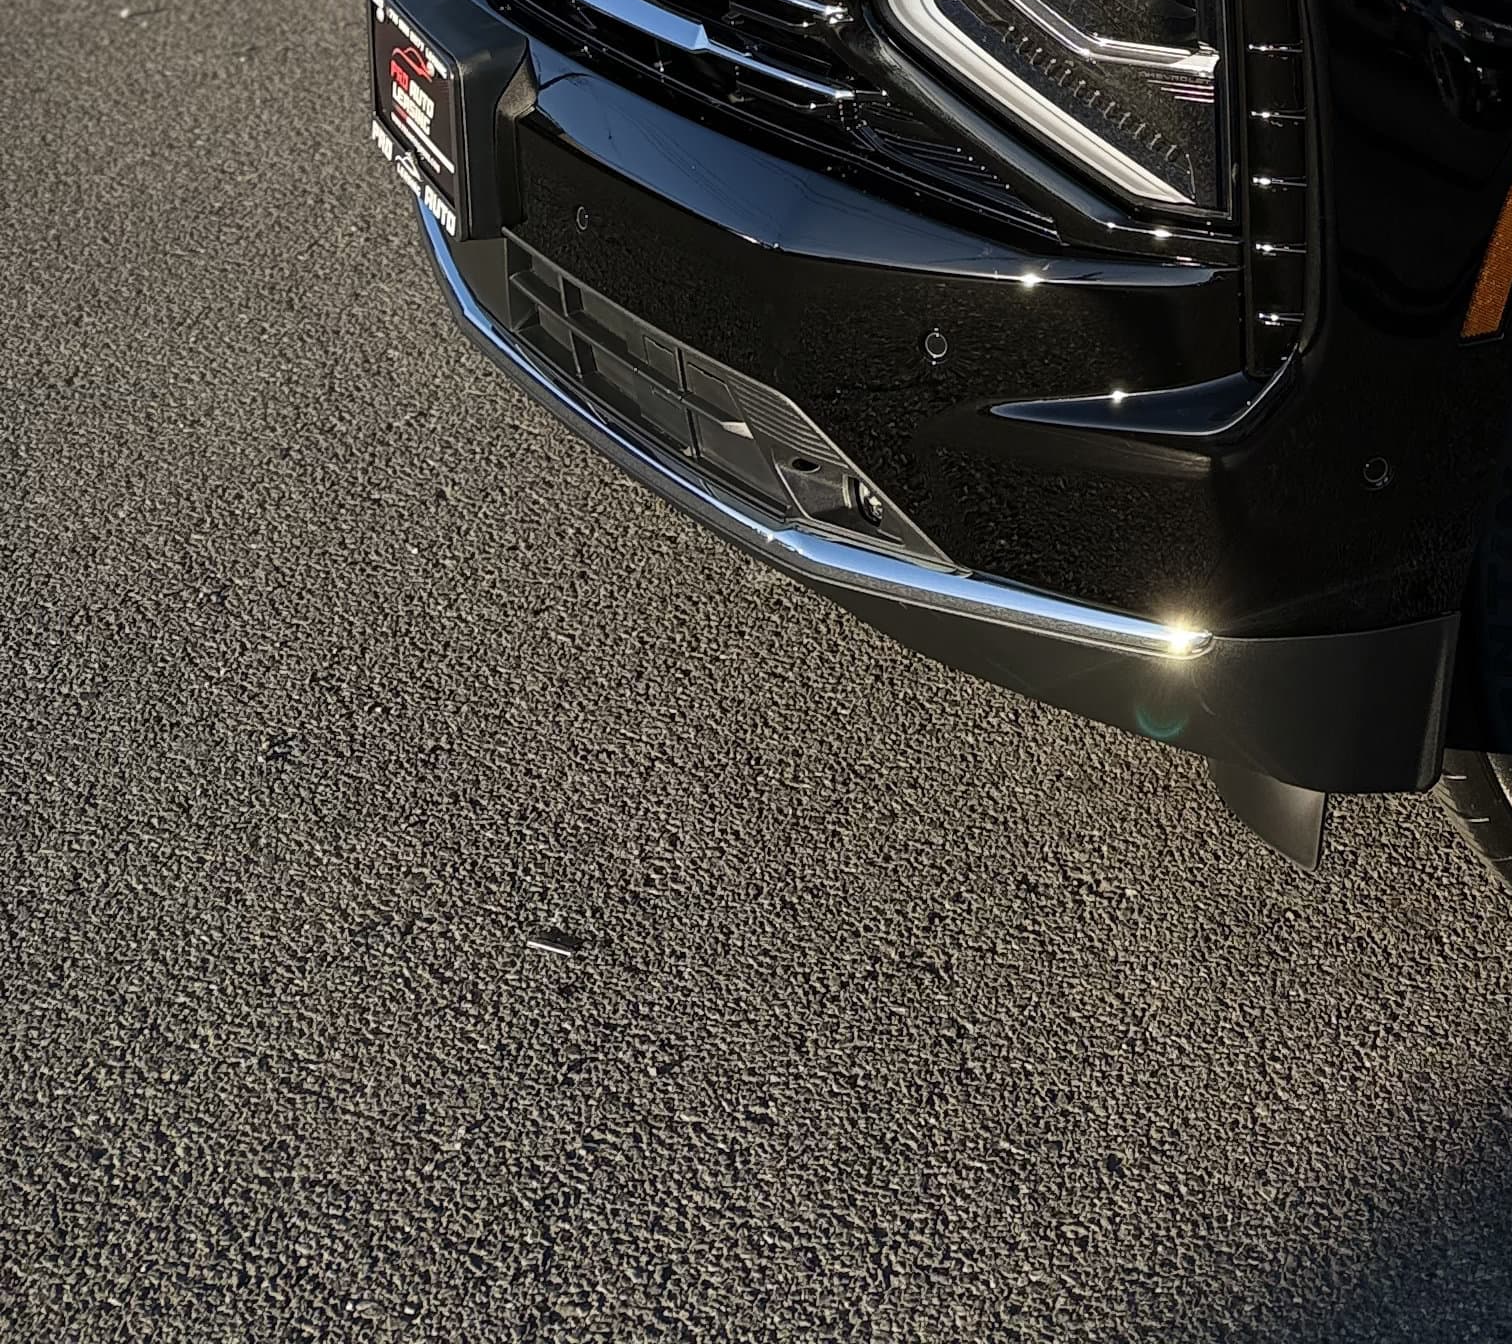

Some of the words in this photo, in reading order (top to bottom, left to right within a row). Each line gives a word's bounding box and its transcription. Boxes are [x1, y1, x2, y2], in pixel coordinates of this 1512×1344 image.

[391, 81, 432, 136] LEASING
[409, 79, 435, 120] AUTO
[371, 119, 394, 162] PRO
[424, 184, 457, 238] AUTO
